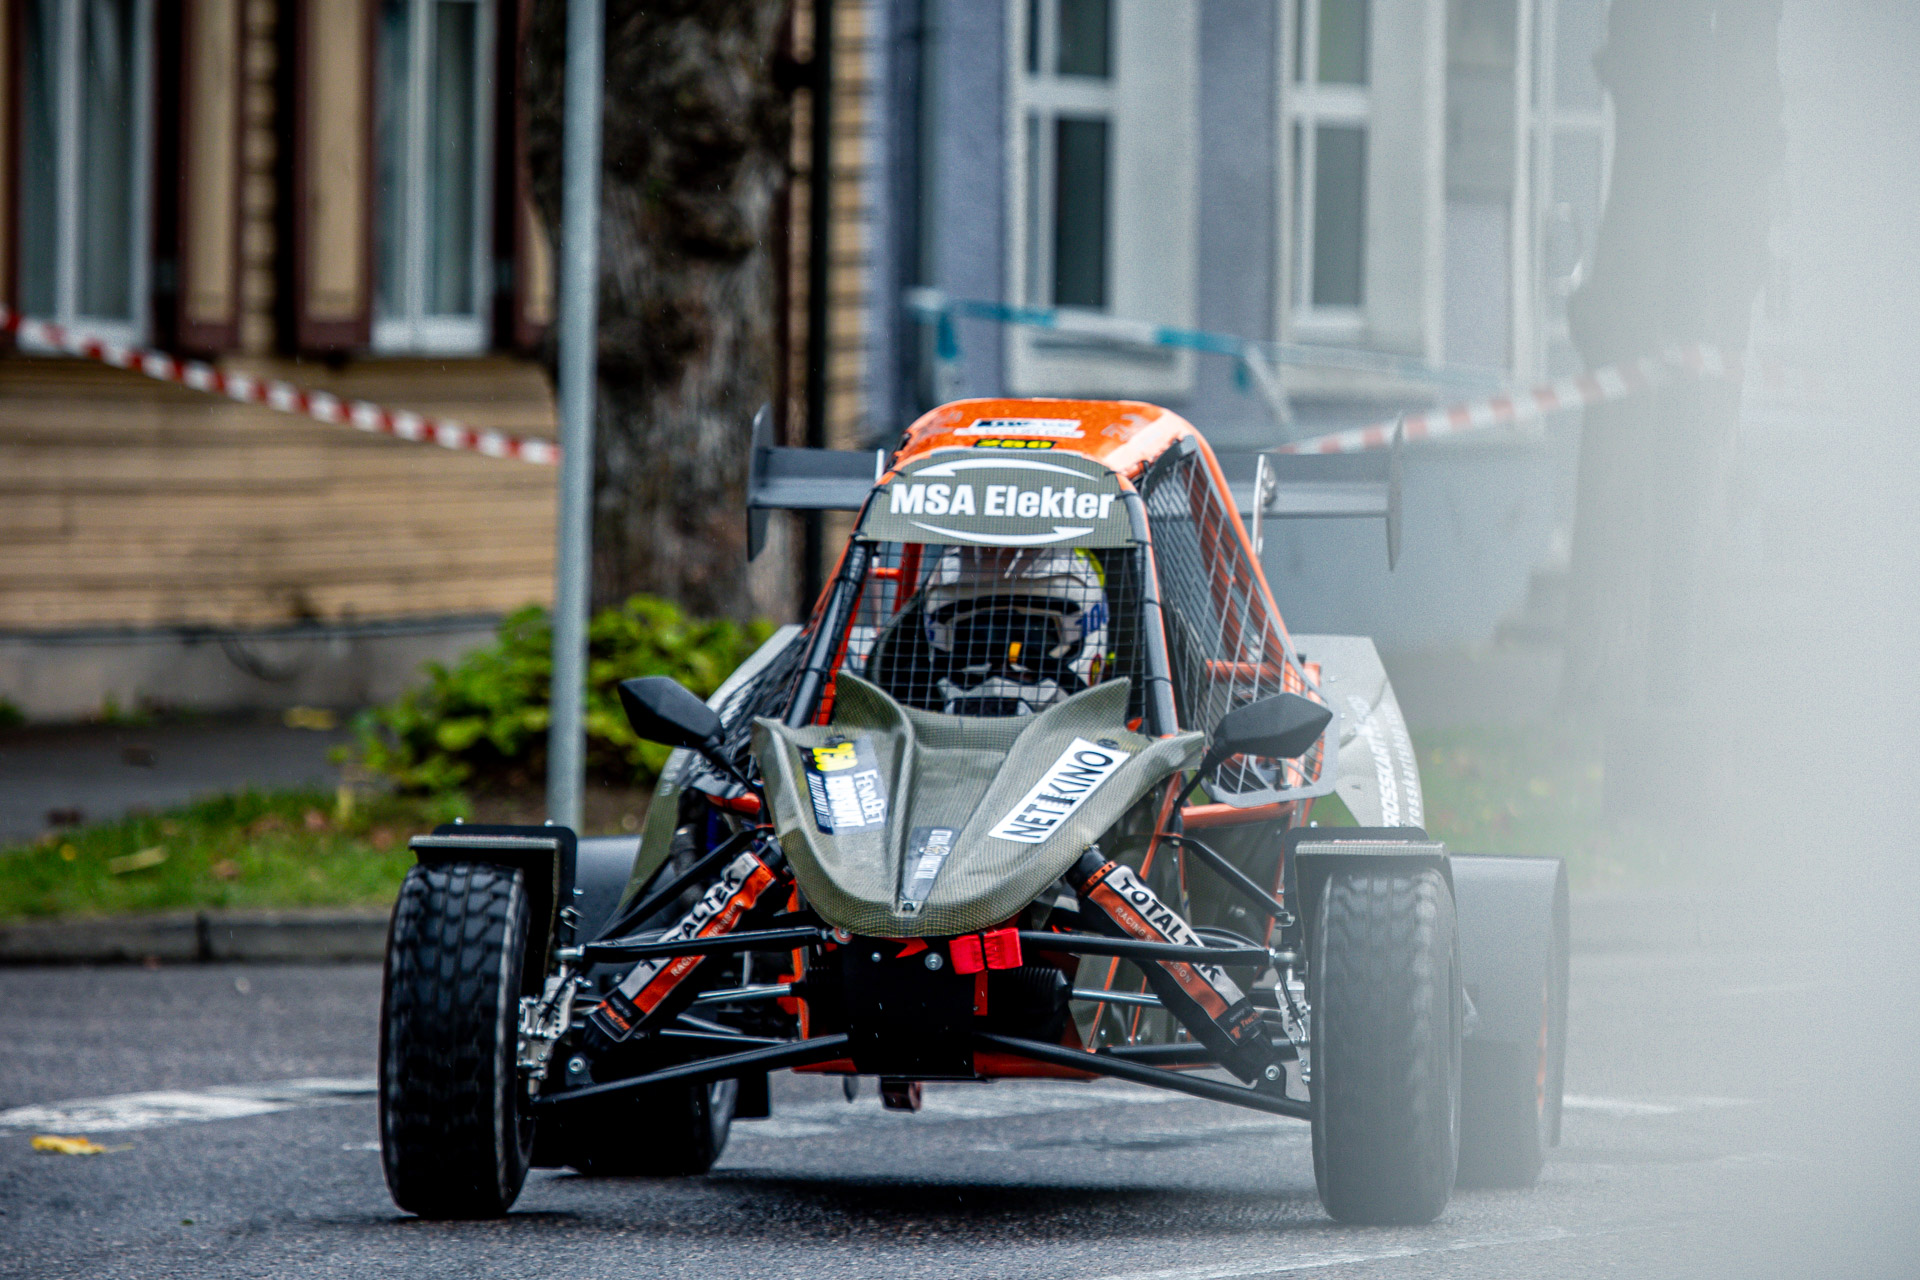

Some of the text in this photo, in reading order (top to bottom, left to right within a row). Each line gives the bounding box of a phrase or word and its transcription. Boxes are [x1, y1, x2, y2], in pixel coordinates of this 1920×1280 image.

[890, 483, 1116, 520] MSA Elekter
[1115, 906, 1147, 937] RACING
[1117, 877, 1221, 983] TOTALTK
